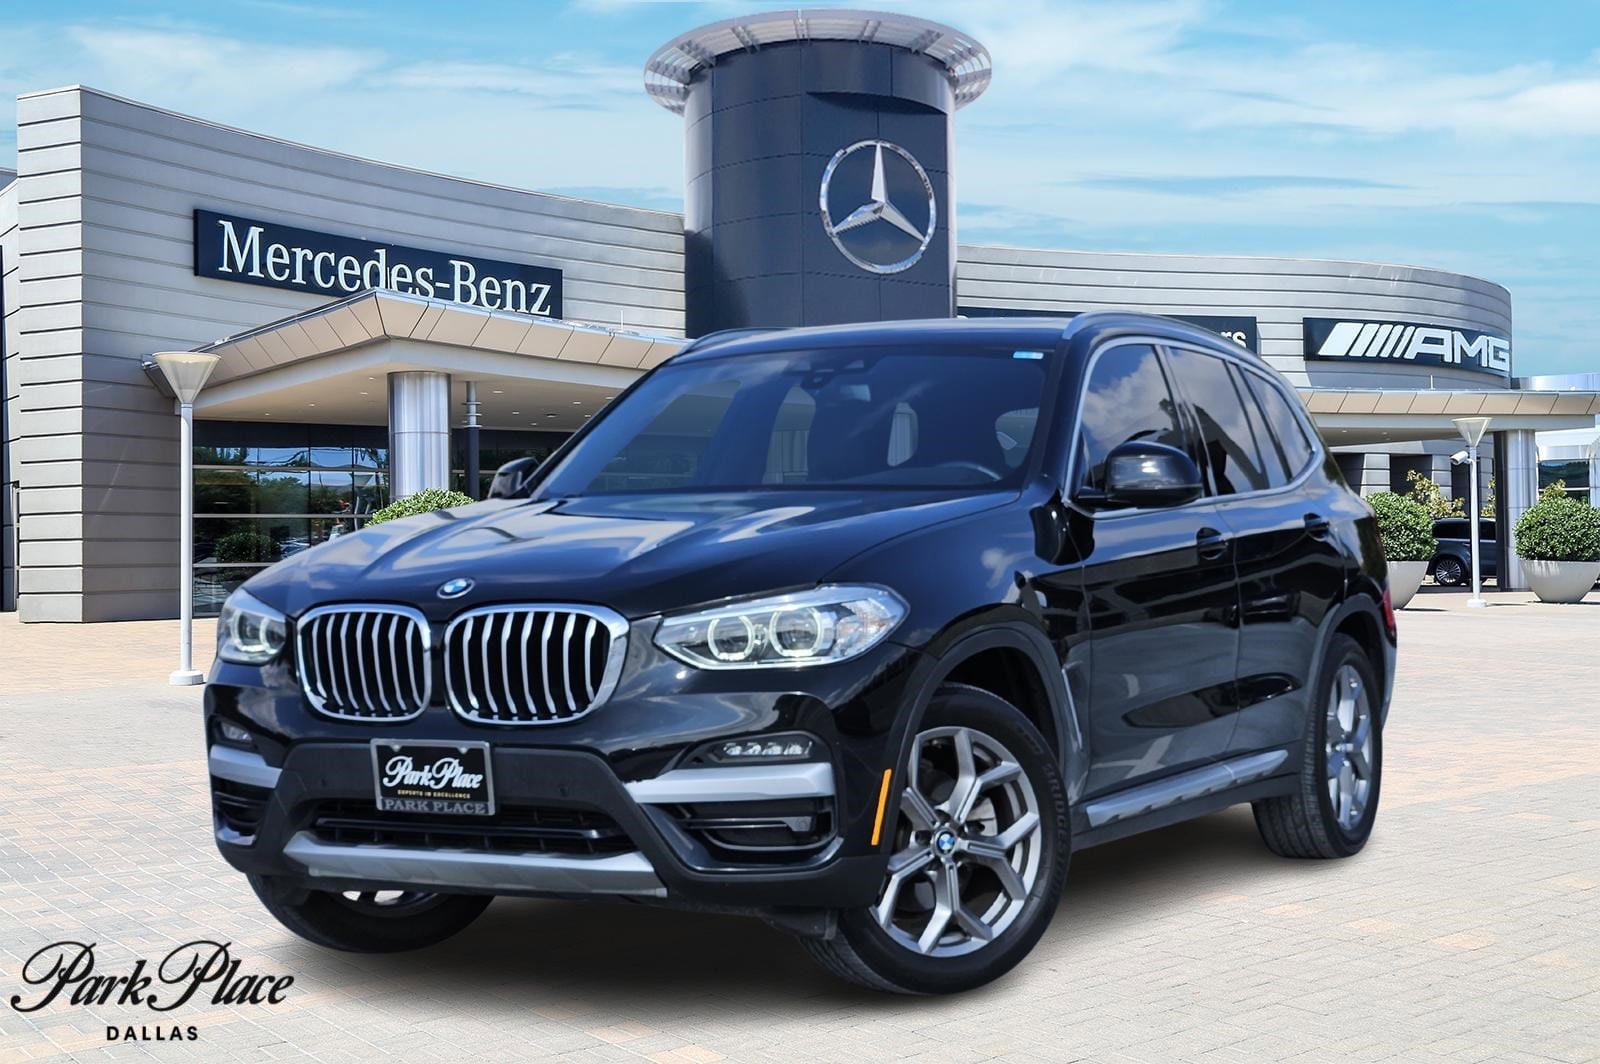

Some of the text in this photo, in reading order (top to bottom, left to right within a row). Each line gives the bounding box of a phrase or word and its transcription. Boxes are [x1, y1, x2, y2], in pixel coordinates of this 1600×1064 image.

[218, 219, 551, 316] Mercedes-Benz
[1404, 327, 1510, 372] AMG
[383, 756, 483, 789] Park Place
[385, 800, 485, 814] PARK PLACE
